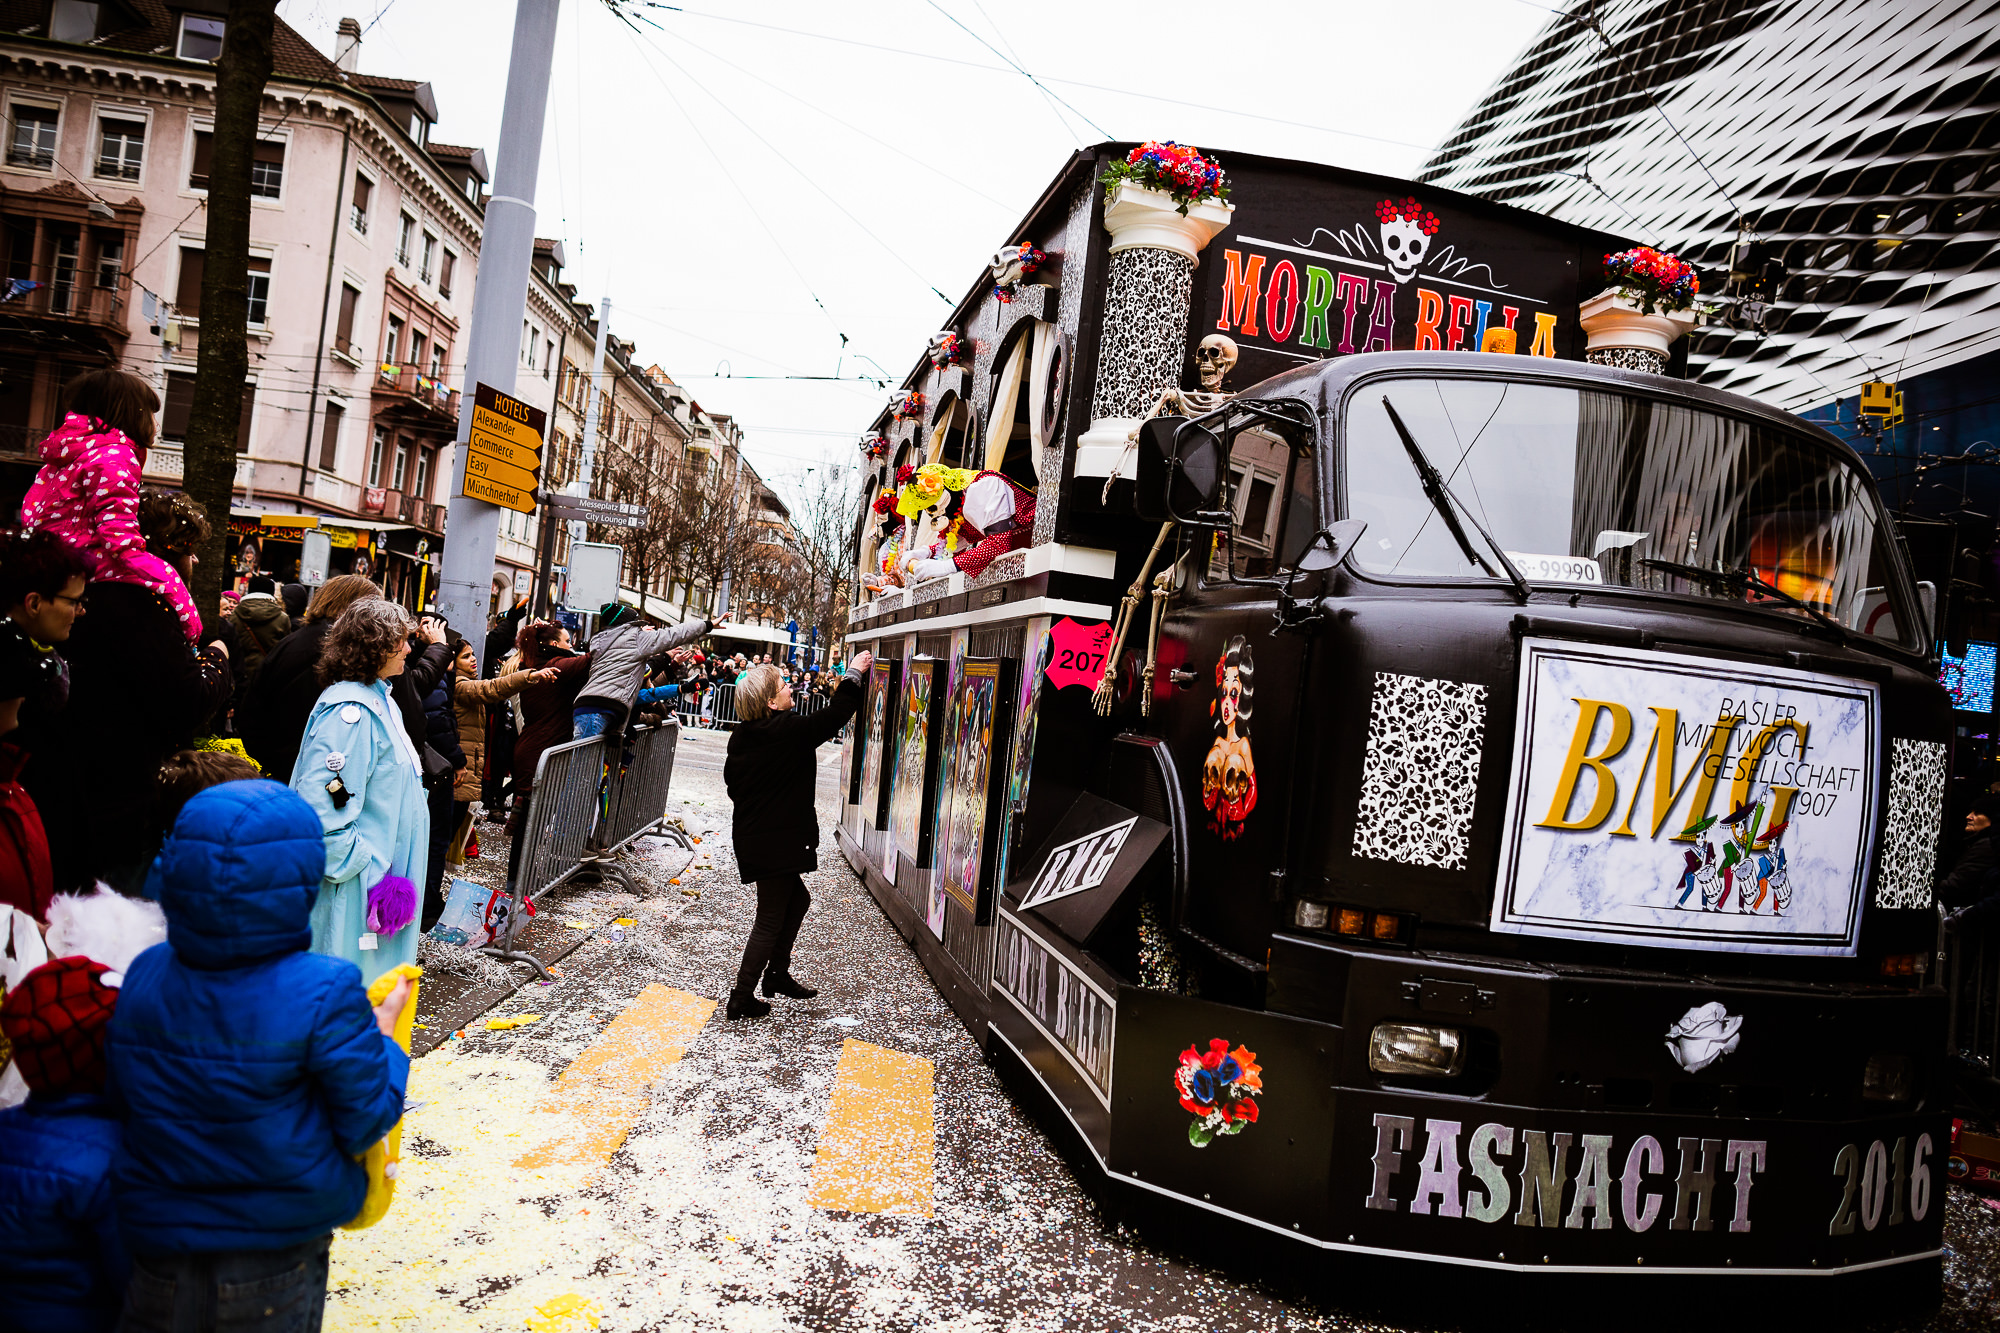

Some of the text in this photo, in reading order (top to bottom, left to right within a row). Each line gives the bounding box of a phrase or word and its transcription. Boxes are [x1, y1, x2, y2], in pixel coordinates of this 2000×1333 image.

[1216, 249, 1398, 354] MORTA
[494, 393, 530, 423] HOTELS
[475, 410, 516, 437] Alexander
[473, 433, 514, 459] Commerce
[470, 455, 489, 476] Easy
[467, 477, 520, 506] Münchnerhof
[579, 499, 618, 512] Messeplatz
[585, 512, 599, 524] City
[601, 514, 627, 526] Lounge
[1511, 559, 1528, 577] S
[1059, 649, 1105, 673] 207
[1718, 697, 1797, 729] BASLER
[1532, 697, 1811, 852] BMG
[1703, 754, 1860, 792] GESELLSCHAFT
[1792, 791, 1837, 818] 1907
[1026, 826, 1128, 904] BMG
[996, 916, 1112, 1094] MORTA BELLA
[1365, 1112, 1934, 1236] FASNACHT 2016
